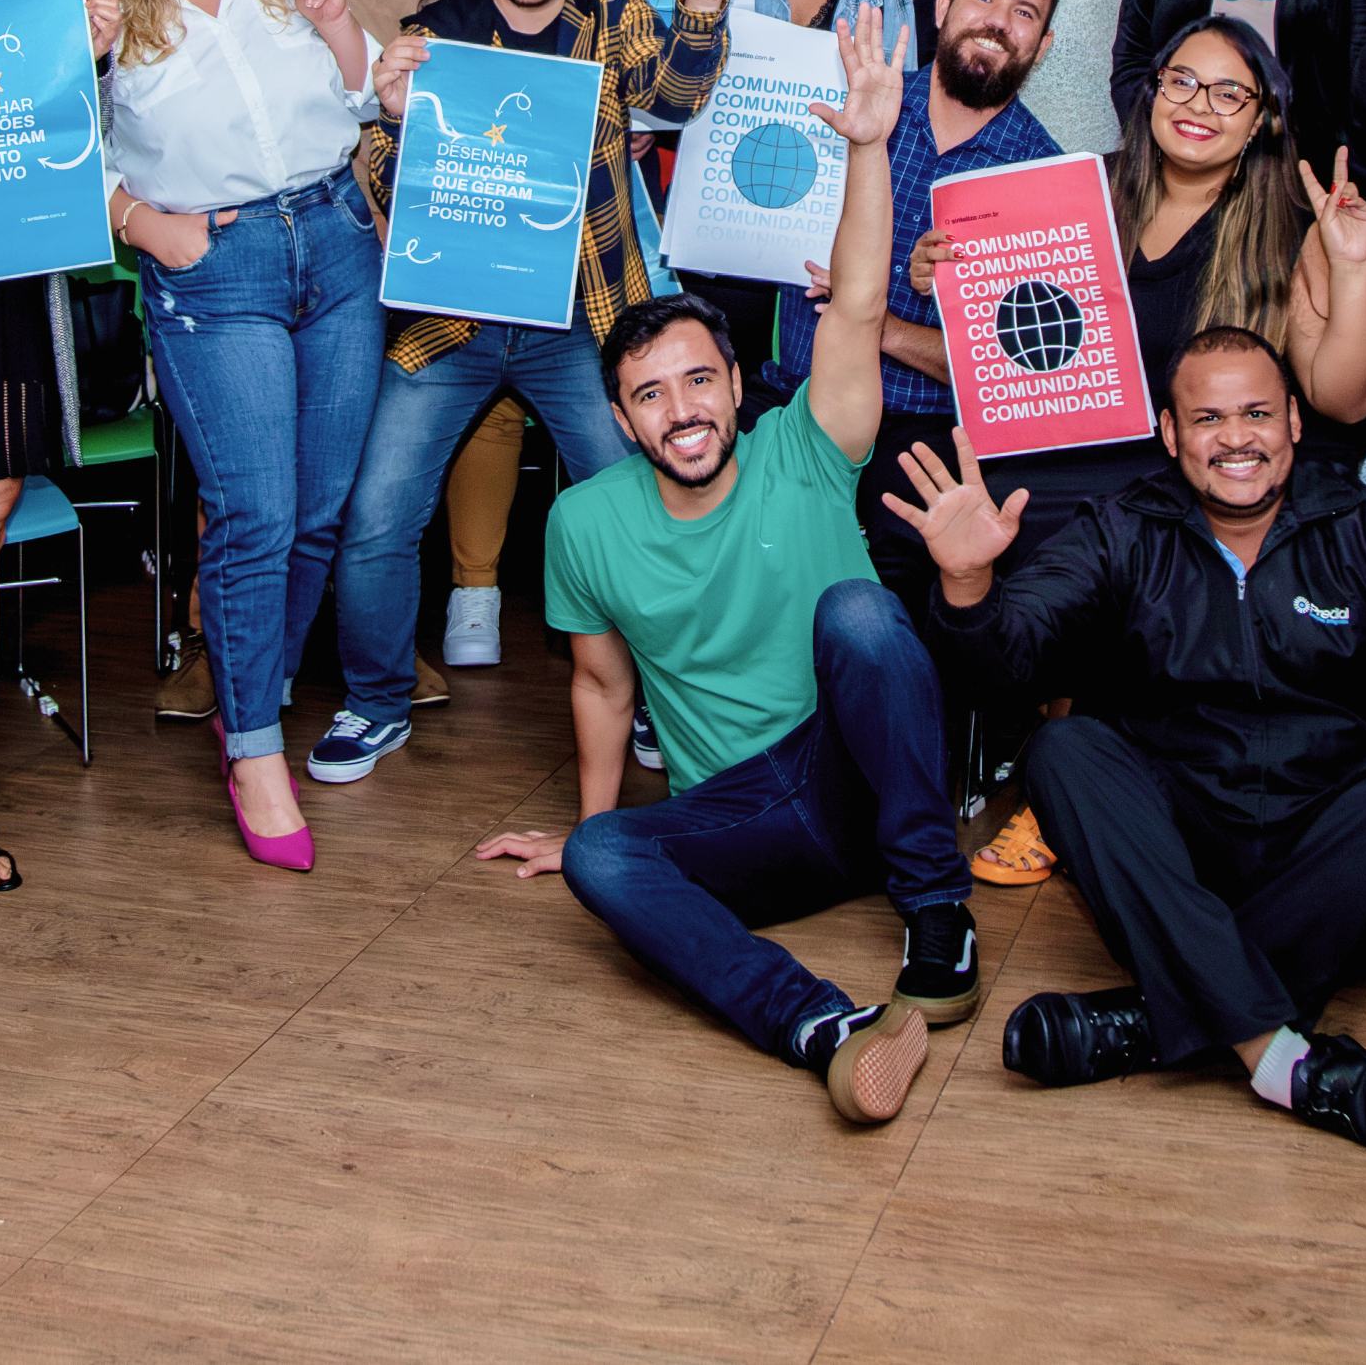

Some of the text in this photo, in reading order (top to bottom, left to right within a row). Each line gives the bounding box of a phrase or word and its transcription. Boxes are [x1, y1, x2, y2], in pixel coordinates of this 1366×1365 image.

[717, 73, 849, 104] COMUNIDADE
[715, 92, 817, 117] COMUNID
[437, 142, 528, 168] DESENHAR
[435, 159, 527, 184] SOLUÇÕES
[430, 190, 505, 212] IMPACTO
[432, 175, 533, 201] QUE GERAM
[428, 206, 507, 228] POSITIVO
[698, 205, 834, 235] COMUNIDADE
[955, 244, 1095, 279] COMUNIDADE
[975, 347, 1117, 382] COMADE
[978, 368, 1121, 403] COMUNIDADE
[982, 389, 1124, 424] COMUNIDADE
